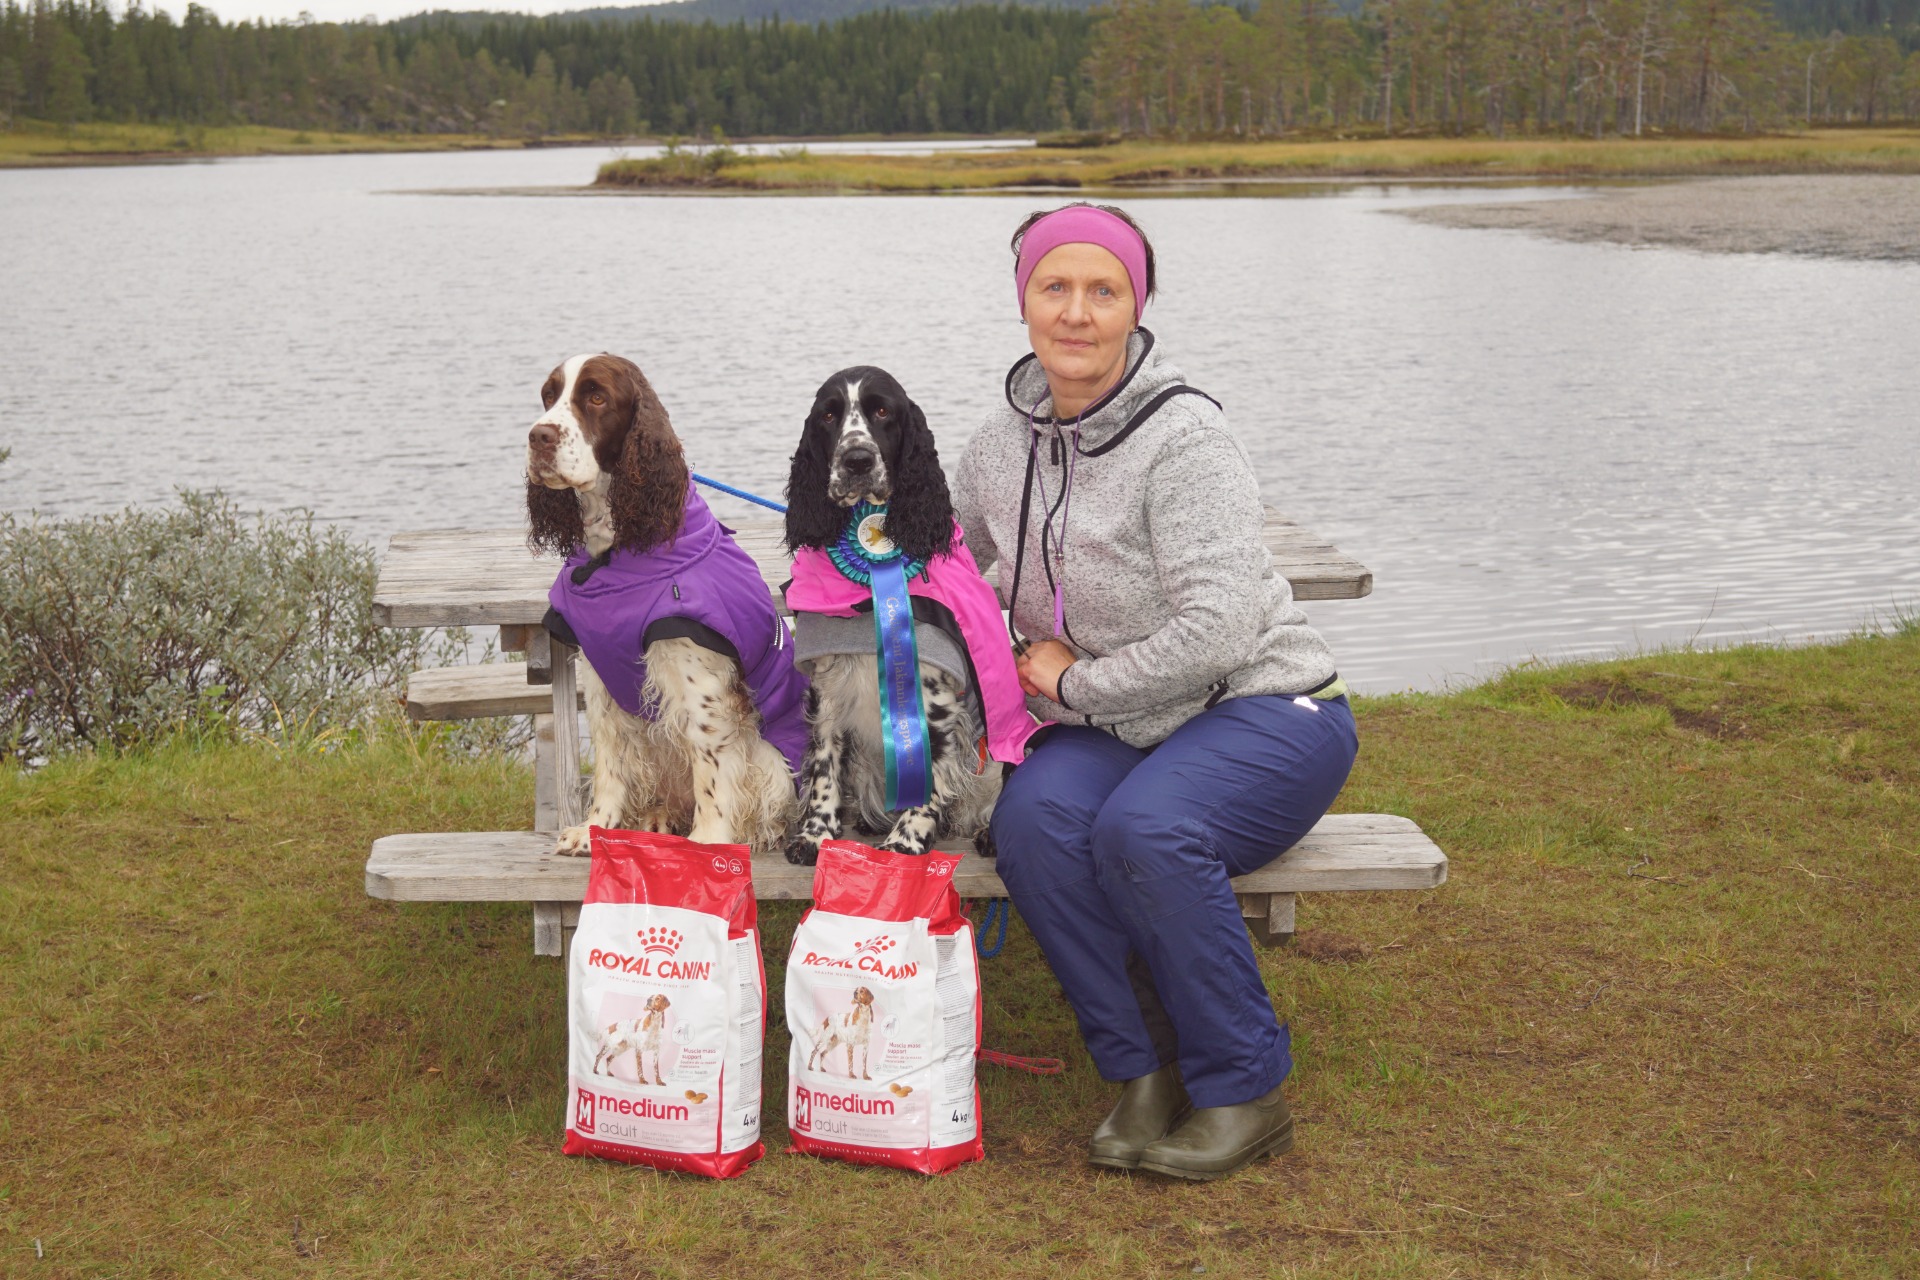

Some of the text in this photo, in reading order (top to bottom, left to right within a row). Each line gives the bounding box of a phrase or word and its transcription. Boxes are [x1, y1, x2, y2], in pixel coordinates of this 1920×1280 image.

[588, 948, 652, 977] ROYAL
[657, 960, 711, 981] CANIN
[858, 956, 917, 980] CANIN
[578, 1096, 592, 1127] M
[599, 1095, 689, 1121] medium
[797, 1095, 809, 1124] M
[813, 1091, 895, 1115] medium
[599, 1121, 638, 1138] adult
[814, 1119, 848, 1134] adult
[960, 1112, 967, 1123] kg
